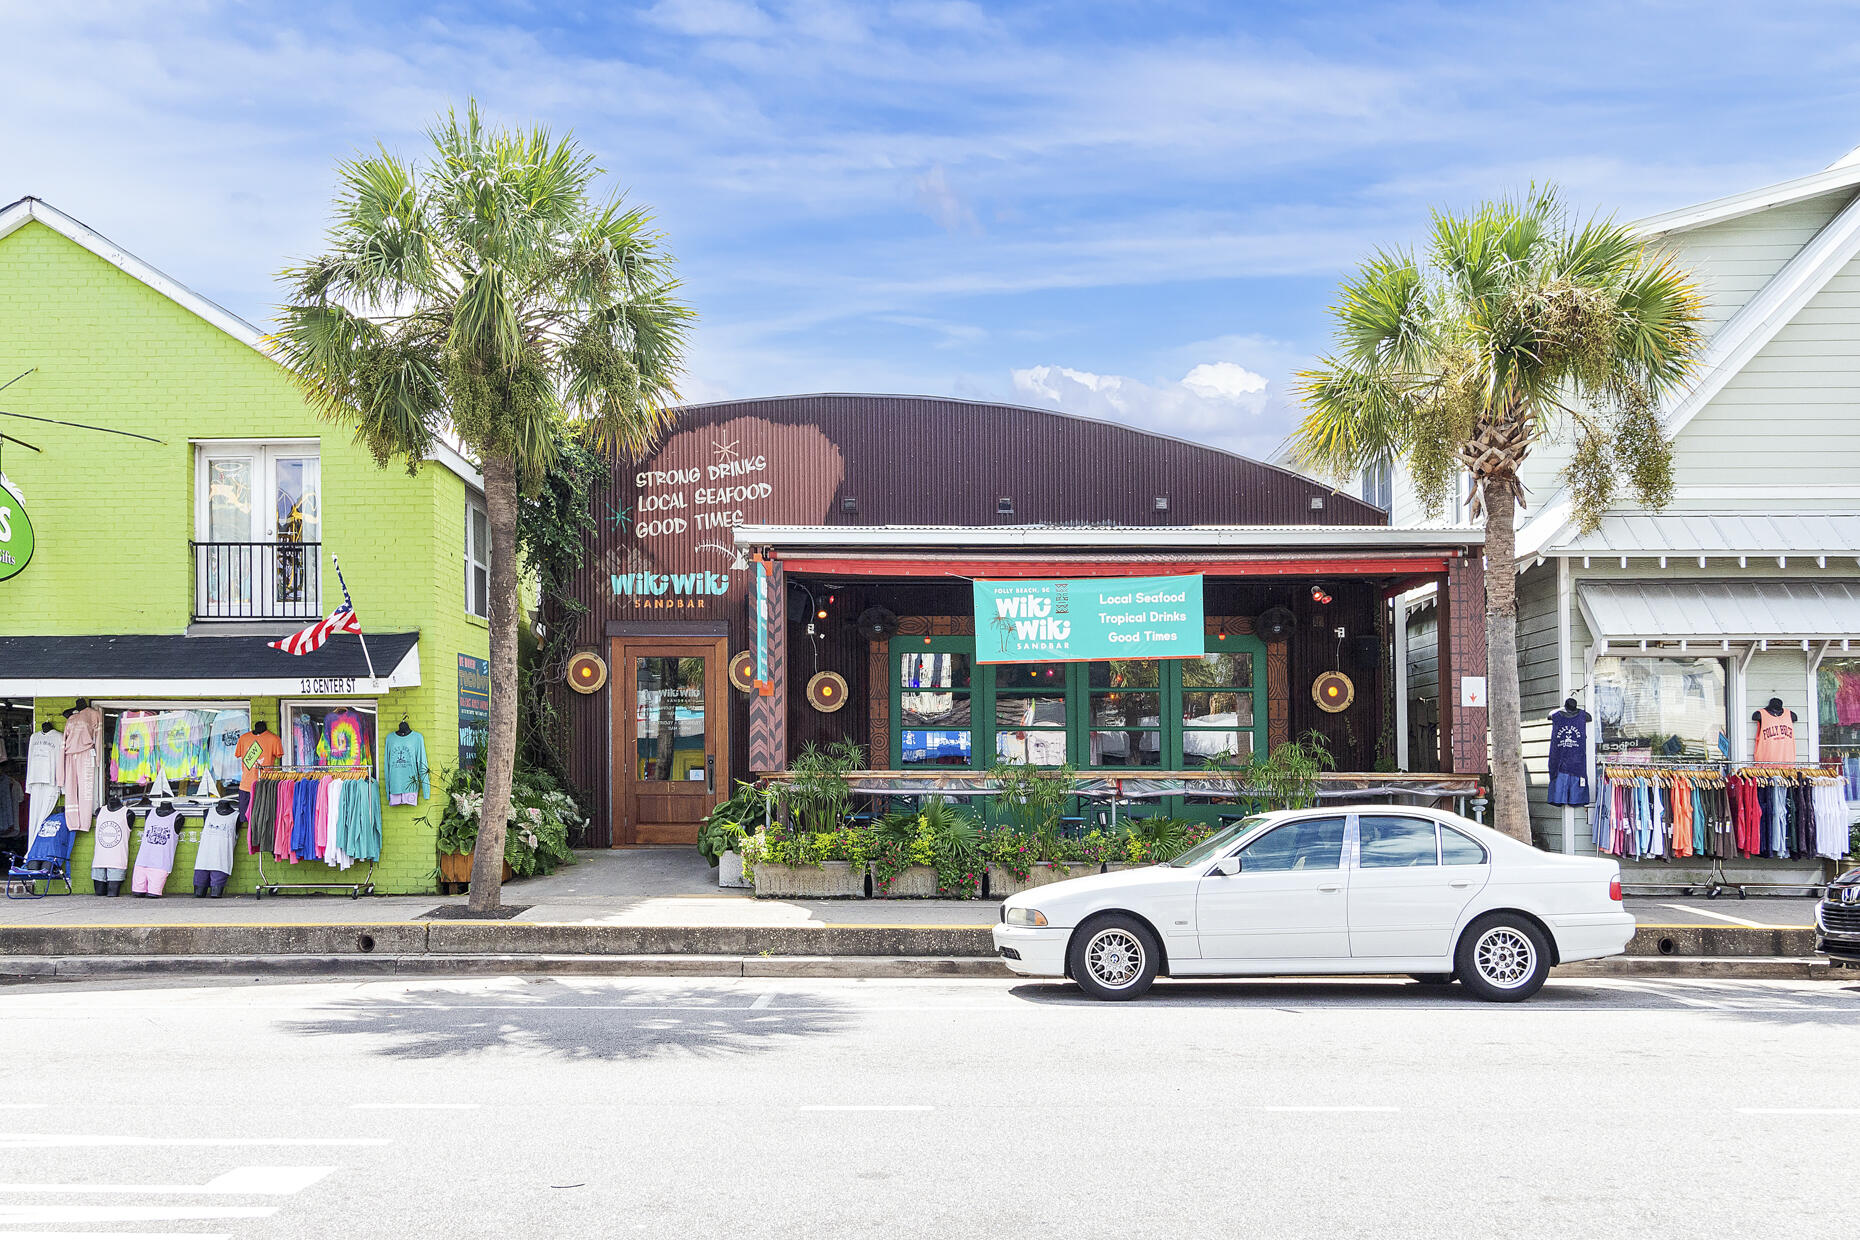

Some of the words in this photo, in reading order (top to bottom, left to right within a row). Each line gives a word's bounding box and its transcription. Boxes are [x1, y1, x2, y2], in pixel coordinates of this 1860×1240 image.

[635, 467, 701, 488] STRONG
[707, 455, 767, 481] DRINKS
[638, 491, 688, 512] LOCAL
[694, 482, 772, 505] SEAFOOD
[635, 517, 688, 539] GOOD
[694, 509, 744, 531] TIMES
[634, 599, 706, 609] SANDBAR
[1099, 592, 1132, 605] Local
[1135, 591, 1186, 604] Seafood
[995, 594, 1052, 619] Wiki
[1098, 611, 1147, 626] Tropical
[1149, 610, 1187, 623] Drinks
[1014, 616, 1072, 641] Wiki
[1107, 631, 1141, 643] Good
[1143, 630, 1178, 642] Times
[1016, 641, 1070, 651] SANDBAR
[300, 679, 311, 694] 13
[313, 678, 345, 694] CENTER
[346, 678, 356, 693] ST
[1763, 725, 1779, 740] FOLLY
[245, 745, 259, 764] NEW
